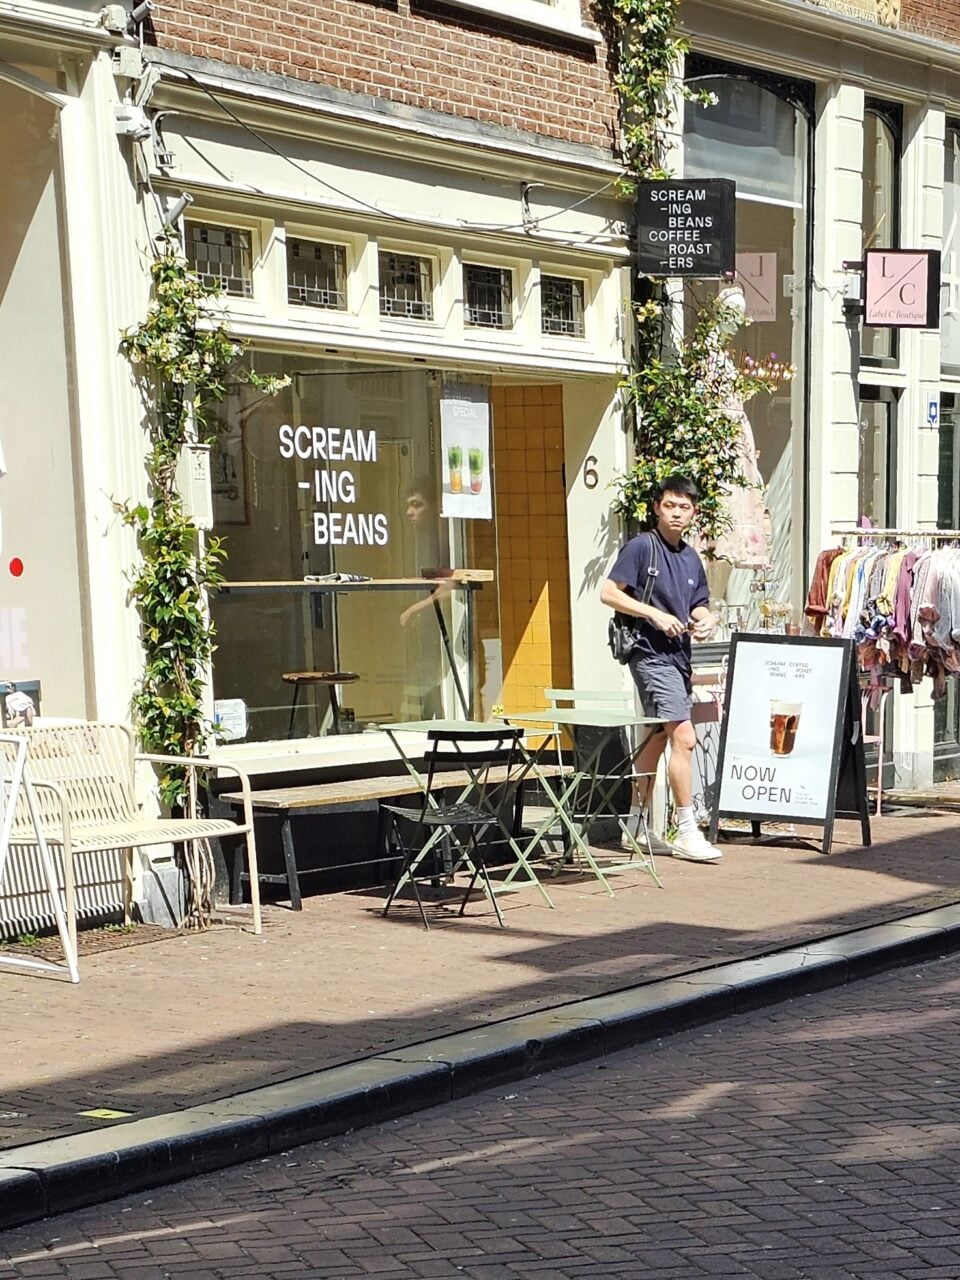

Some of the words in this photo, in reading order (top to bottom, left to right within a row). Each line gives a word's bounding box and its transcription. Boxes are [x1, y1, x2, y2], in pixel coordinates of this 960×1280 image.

[650, 189, 706, 202] SCREAM
[660, 203, 692, 215] -ING
[668, 216, 713, 228] BEANS
[648, 230, 701, 242] COFFEE
[669, 243, 712, 255] ROAST
[660, 257, 694, 269] -ERS
[880, 256, 895, 278] L
[898, 282, 916, 306] C
[868, 309, 887, 319] Label
[888, 310, 896, 319] C
[896, 309, 926, 322] Boutique
[278, 423, 378, 463] SCREAM
[583, 455, 599, 490] 6
[313, 511, 389, 546] BEANS
[731, 764, 777, 783] NOW
[742, 784, 793, 804] OPEN
